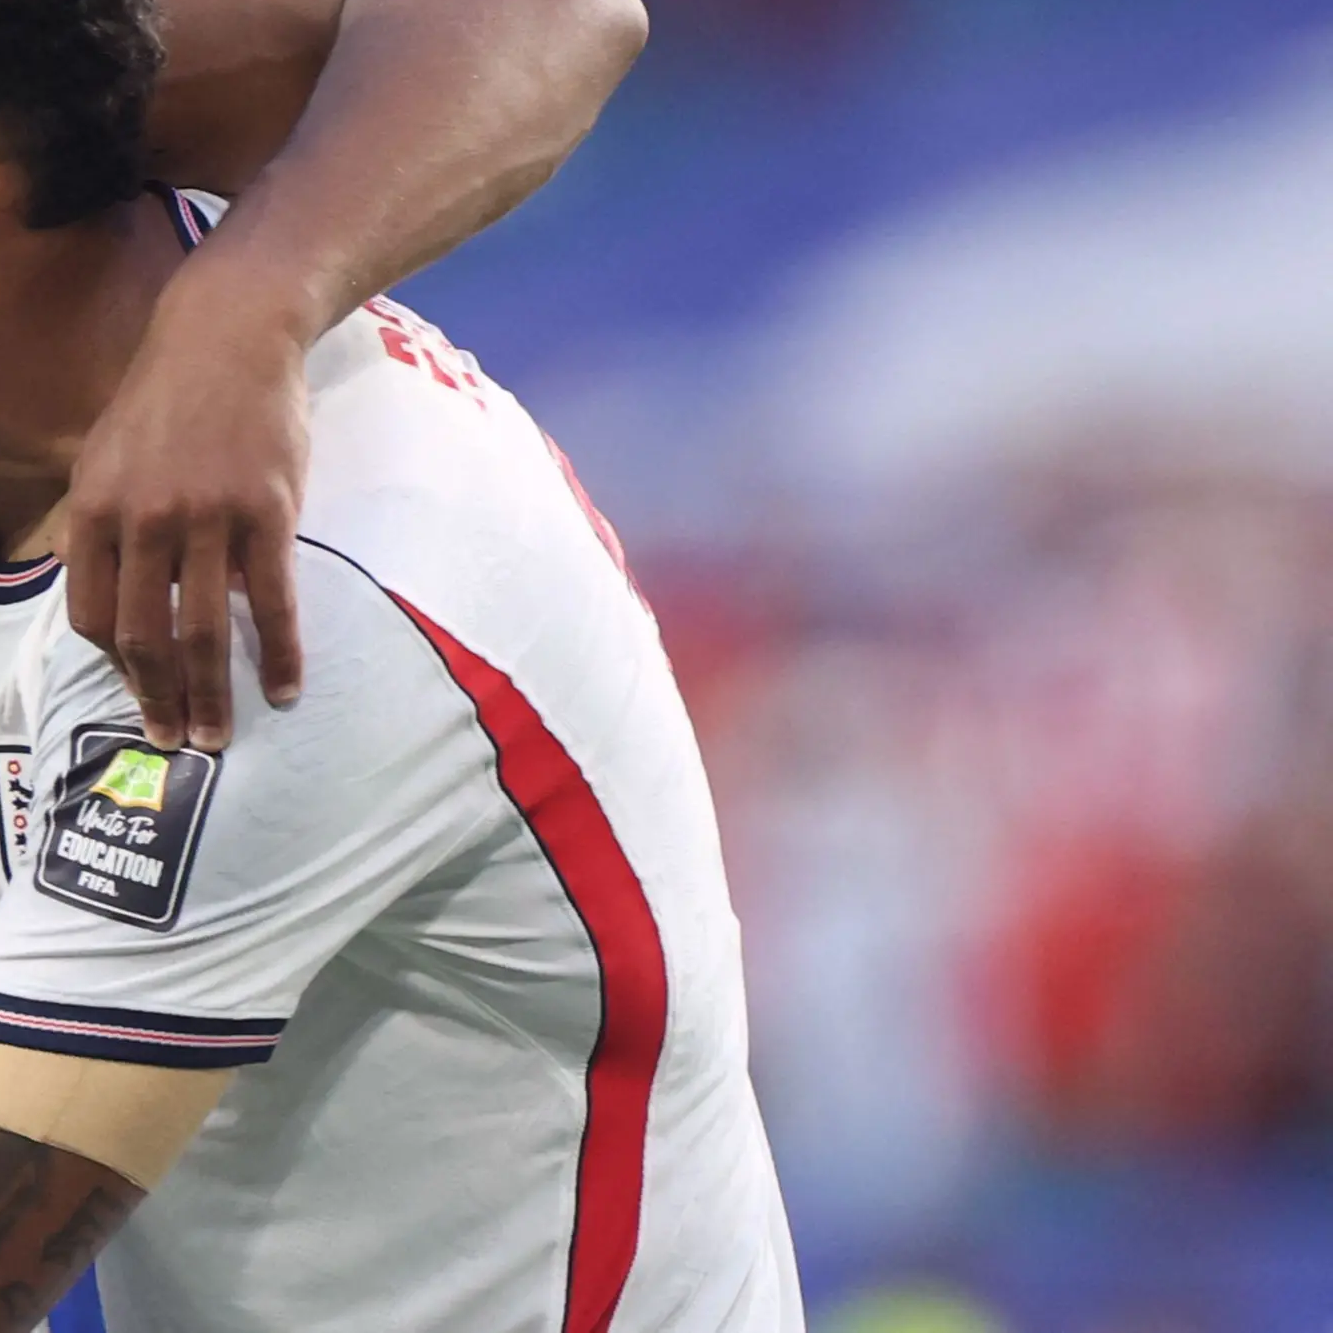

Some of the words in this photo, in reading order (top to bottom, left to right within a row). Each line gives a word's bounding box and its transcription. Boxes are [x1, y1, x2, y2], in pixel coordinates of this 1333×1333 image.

[77, 798, 128, 838] Unite
[126, 815, 160, 846] For
[56, 829, 164, 888] EDUCATION
[77, 870, 118, 897] FIFA
